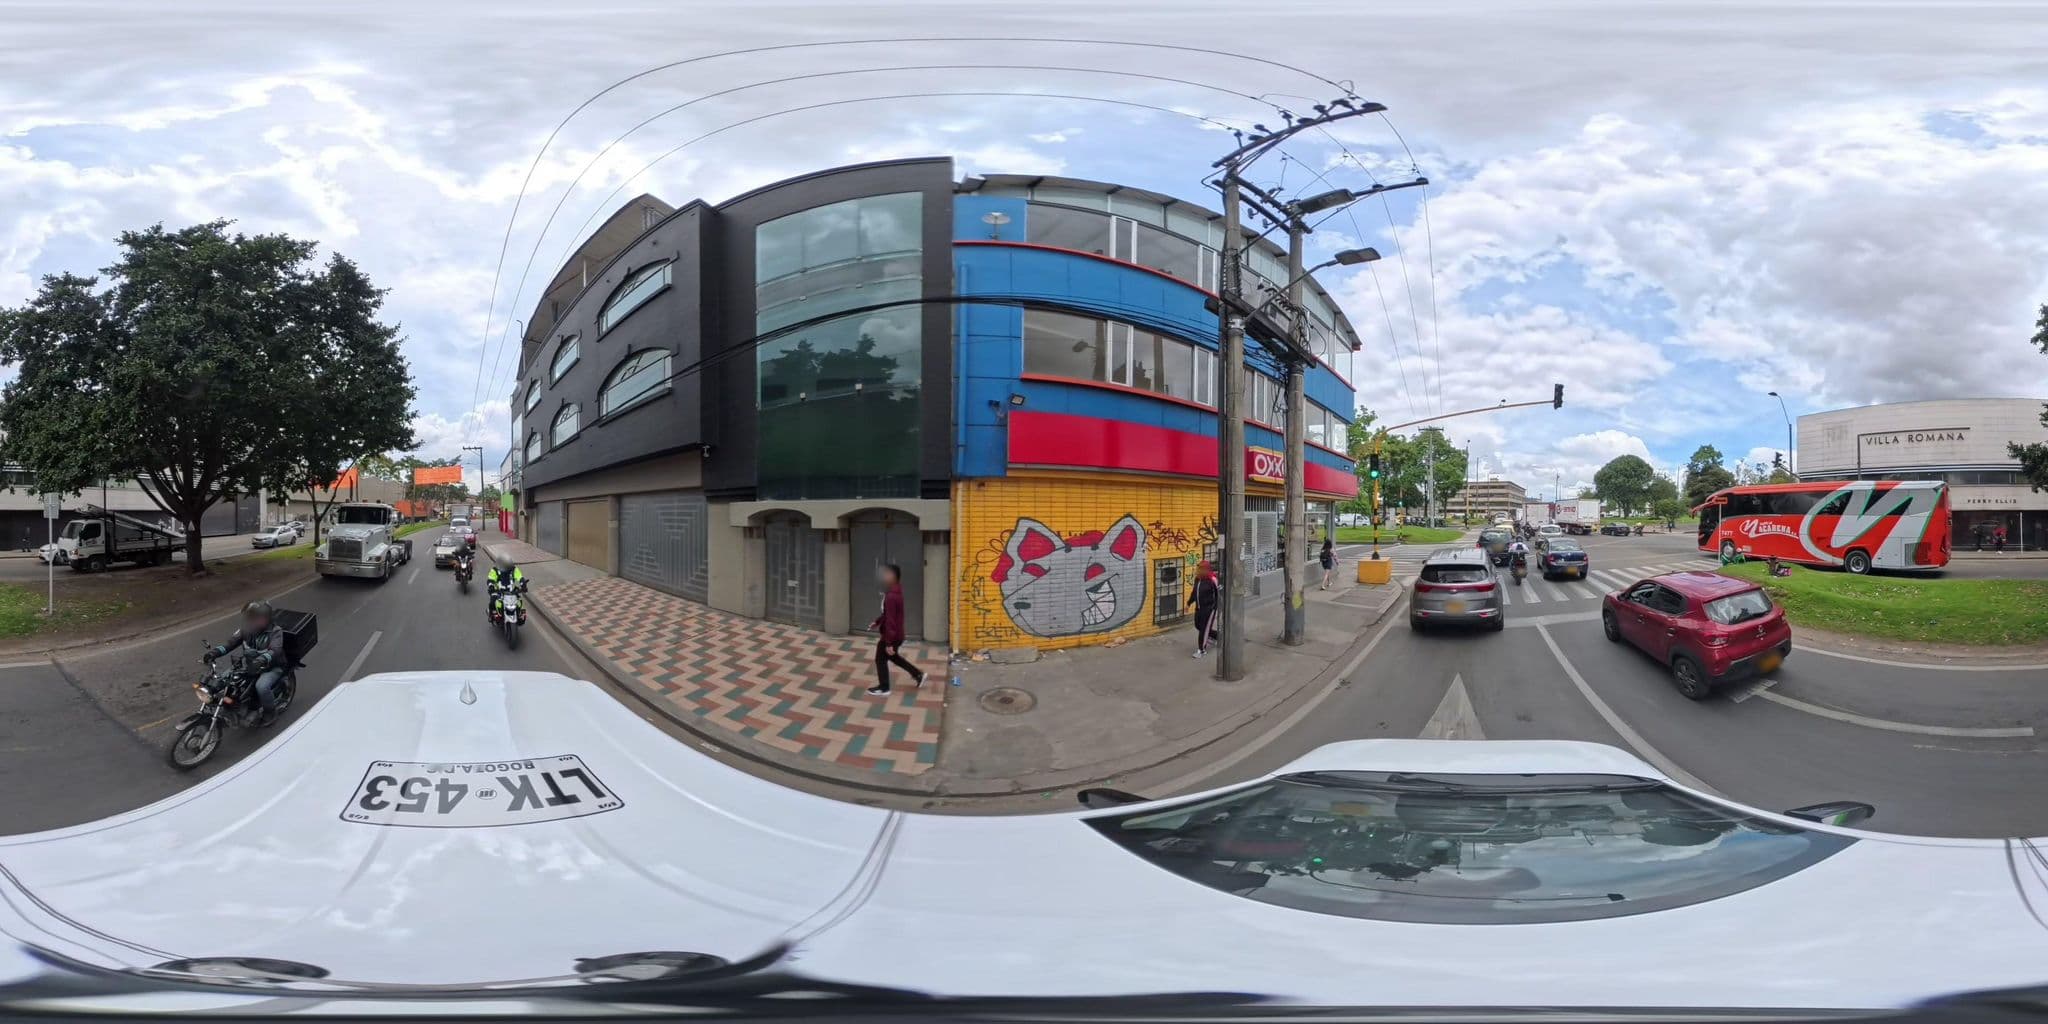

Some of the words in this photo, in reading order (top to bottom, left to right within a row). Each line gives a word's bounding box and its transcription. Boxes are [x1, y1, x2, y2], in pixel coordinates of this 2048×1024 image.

[1865, 435, 1900, 446] VILLA
[1907, 432, 1965, 444] ROMANA
[359, 774, 469, 815] 453
[495, 767, 607, 812] LTK
